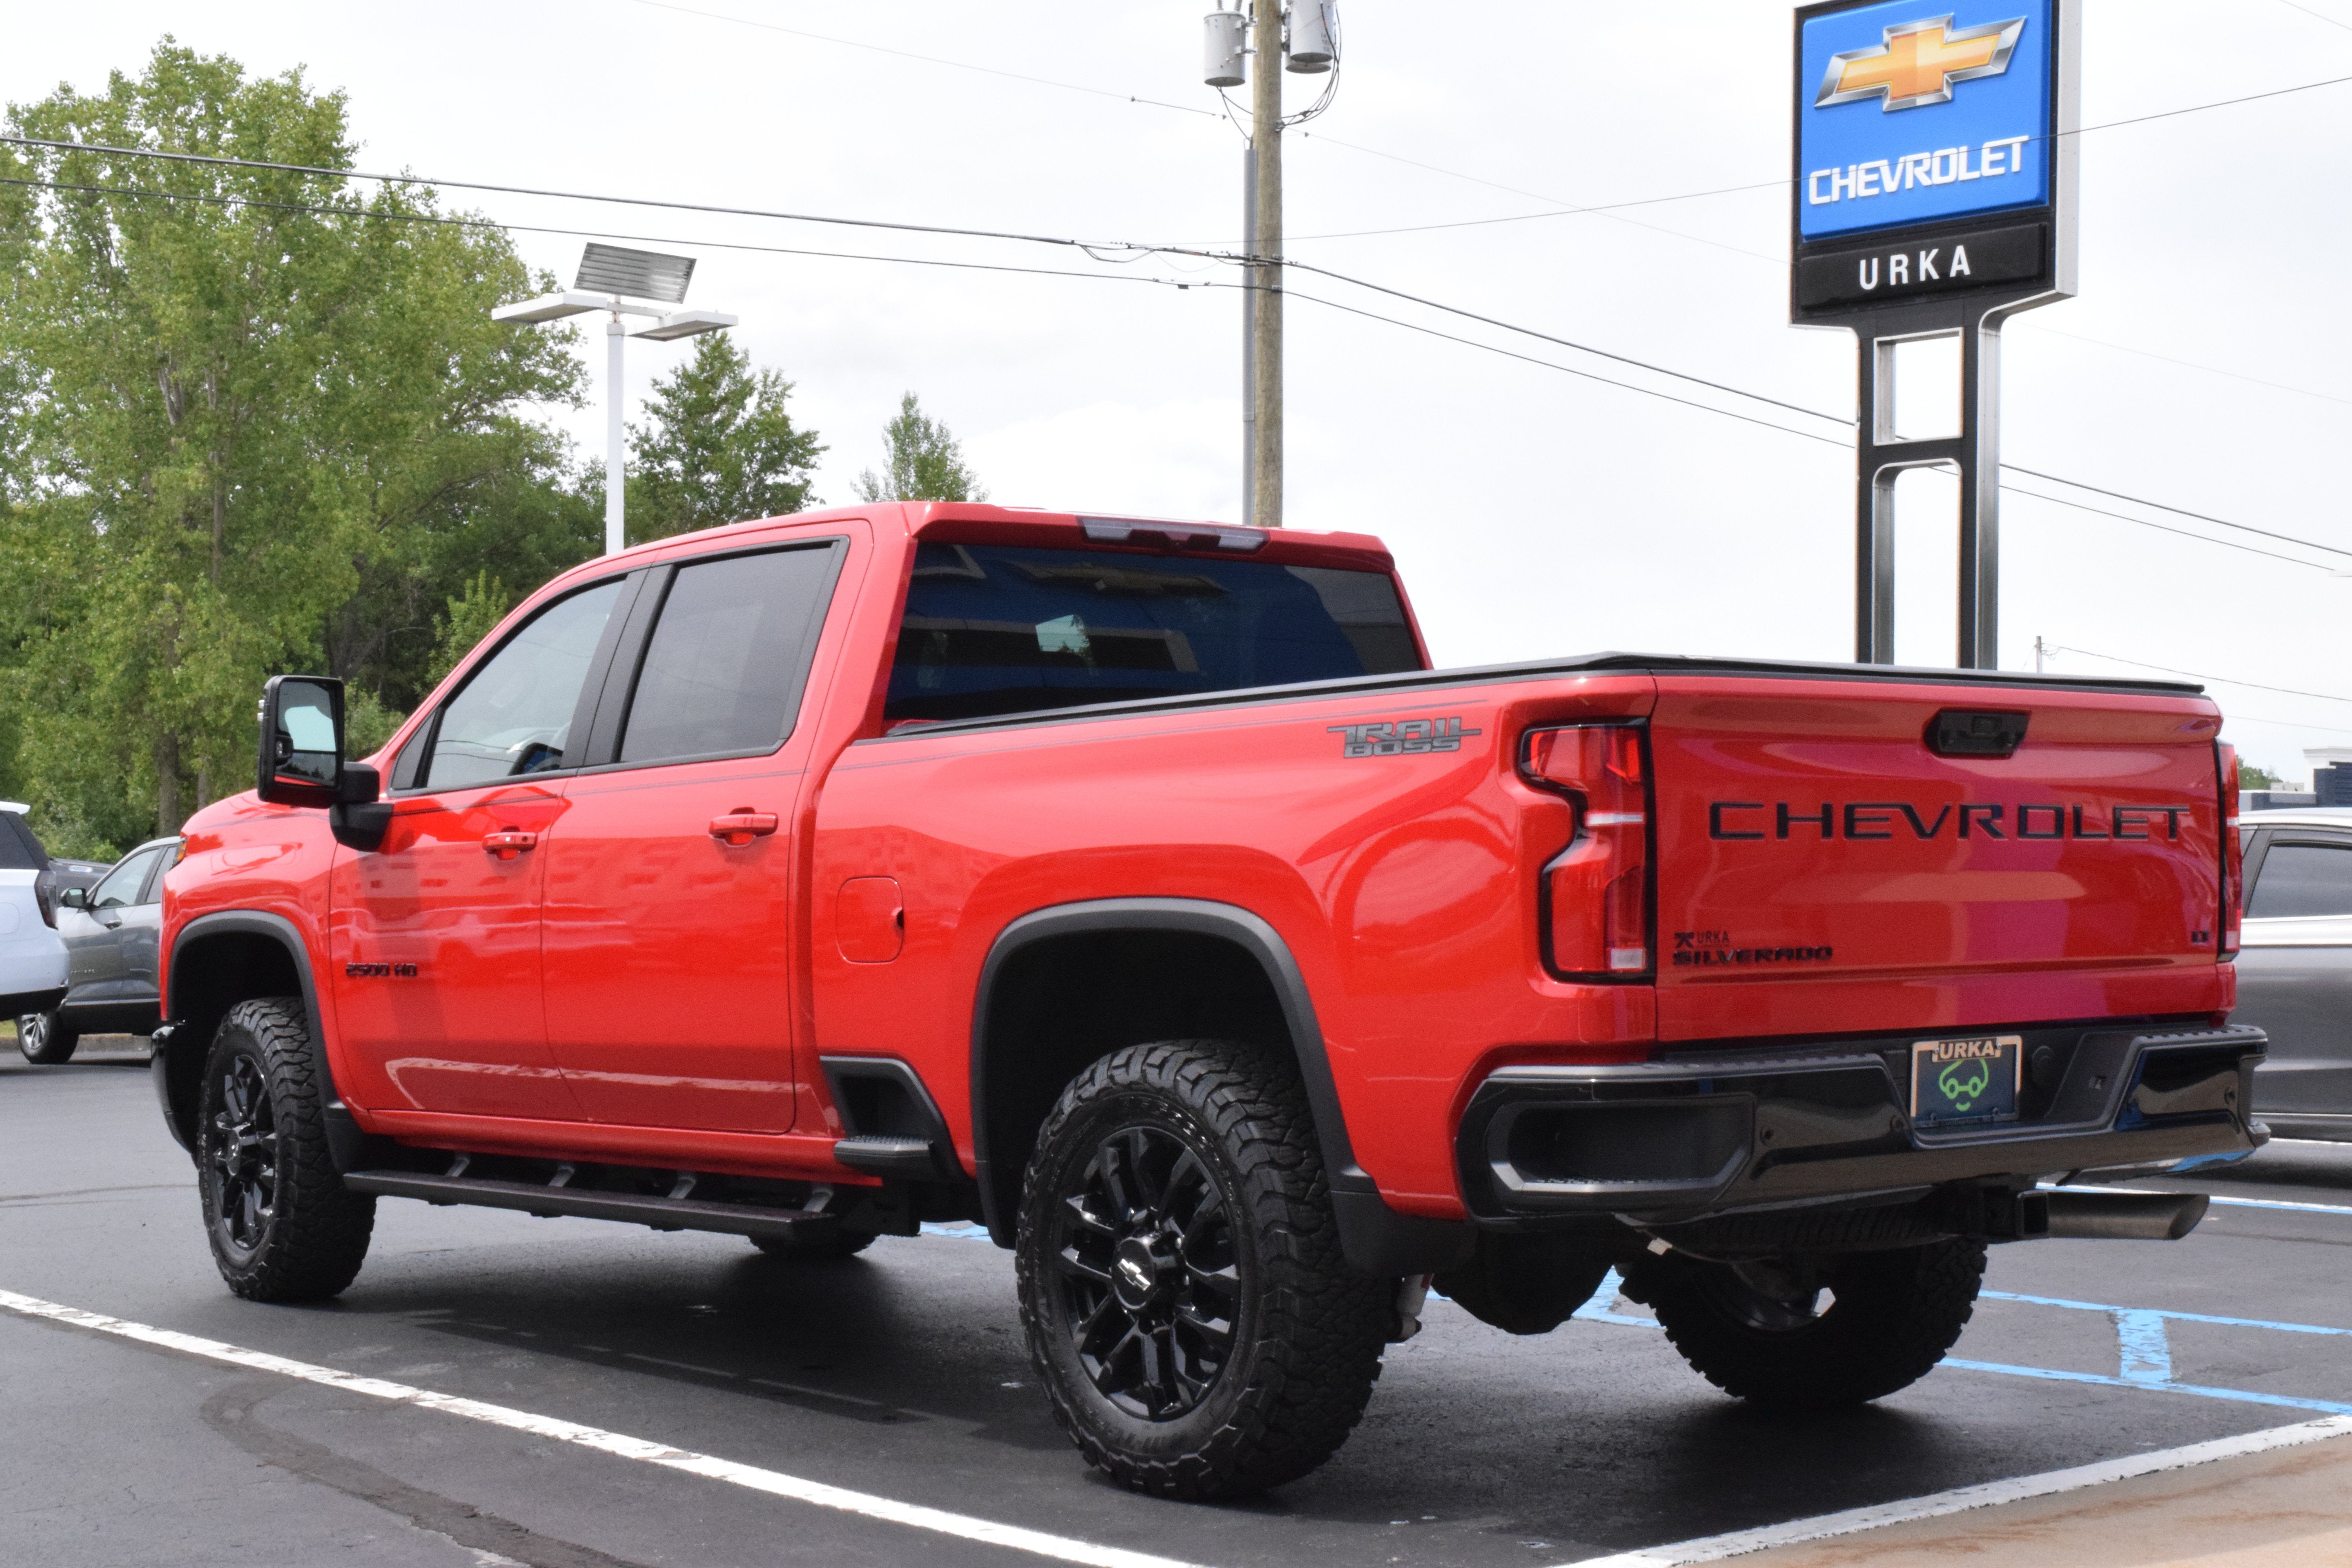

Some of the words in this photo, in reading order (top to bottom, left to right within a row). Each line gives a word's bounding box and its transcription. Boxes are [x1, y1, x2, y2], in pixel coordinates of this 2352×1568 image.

[1809, 135, 2029, 205] CHEVROLET
[1859, 245, 1970, 290] URKA
[1327, 717, 1482, 743] TRAIL
[1343, 736, 1461, 758] BOSS
[1709, 801, 2190, 841] CHEVROLET
[1697, 931, 1730, 944] URKA
[1673, 946, 1833, 965] SILVERADO
[346, 962, 390, 976] 2500
[394, 963, 417, 976] HD
[1940, 1040, 1995, 1059] URKA
